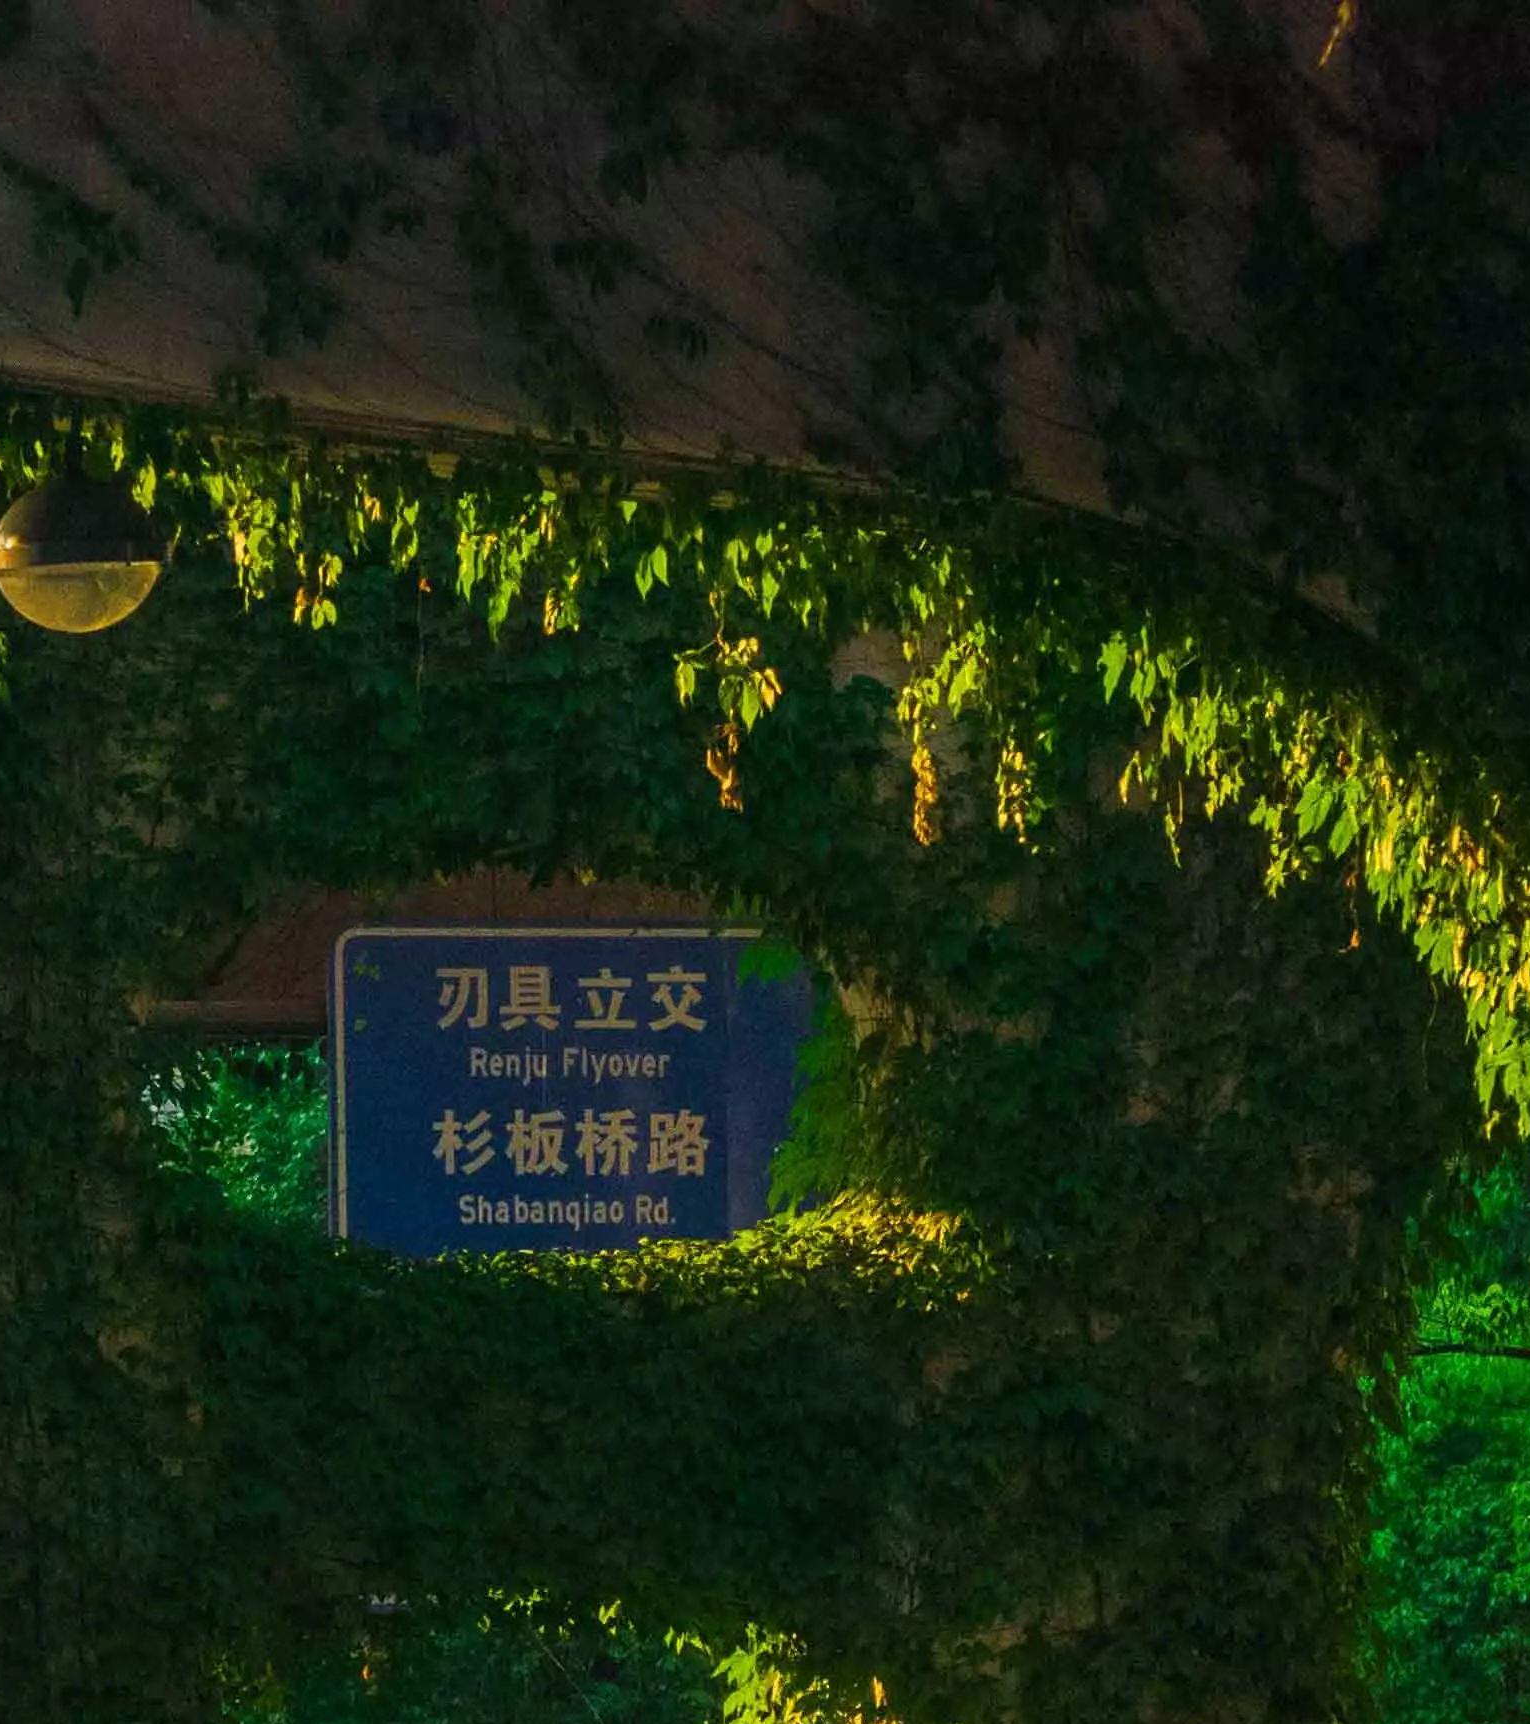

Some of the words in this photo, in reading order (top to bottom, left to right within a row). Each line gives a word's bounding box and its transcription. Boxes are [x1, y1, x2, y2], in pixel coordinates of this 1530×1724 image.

[436, 965, 707, 1032] 刃具立交
[469, 1046, 547, 1086] Renju
[563, 1047, 670, 1084] Flyover
[433, 1108, 710, 1176] 杉板桥路
[459, 1194, 624, 1231] Shabanqiao
[636, 1195, 676, 1225] Rd.
